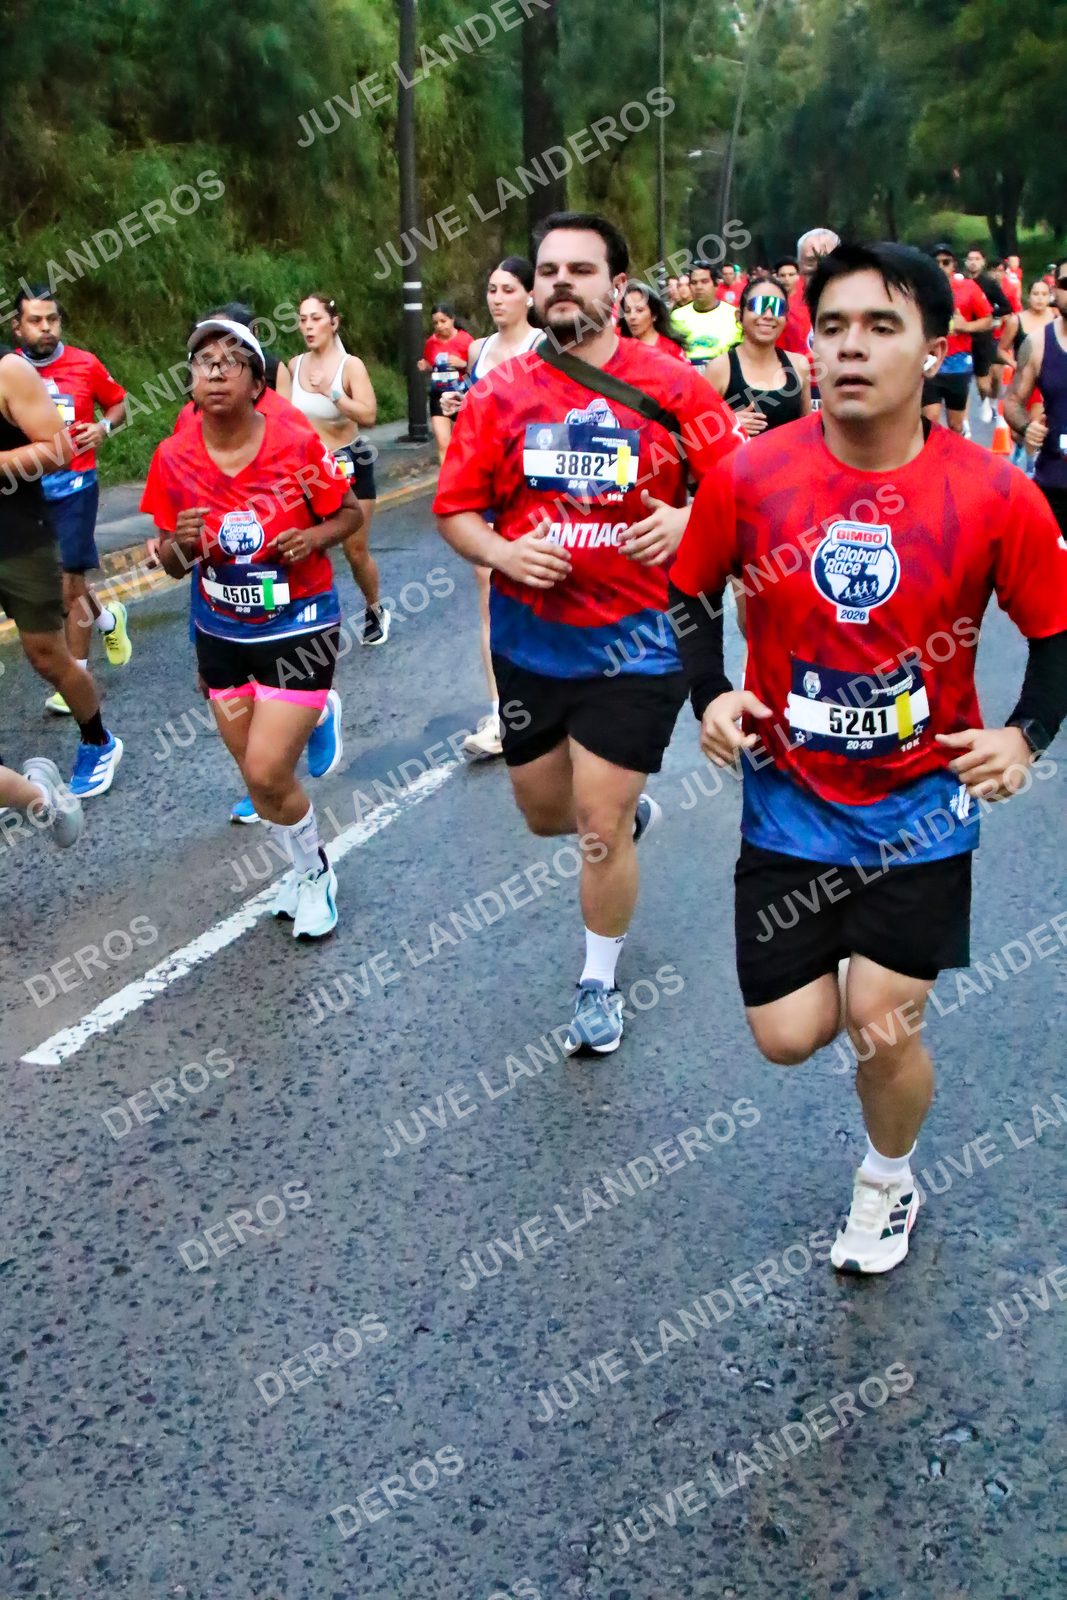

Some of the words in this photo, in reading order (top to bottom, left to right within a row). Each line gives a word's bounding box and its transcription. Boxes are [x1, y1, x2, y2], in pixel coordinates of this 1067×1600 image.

[555, 453, 605, 477] 3882
[836, 529, 883, 544] BIMBO
[834, 545, 881, 565] Global
[824, 557, 862, 576] Race
[222, 587, 261, 604] 4505
[840, 608, 867, 621] 2026
[829, 706, 889, 735] 5241
[846, 739, 874, 750] 20-26
[900, 737, 920, 752] 10K
